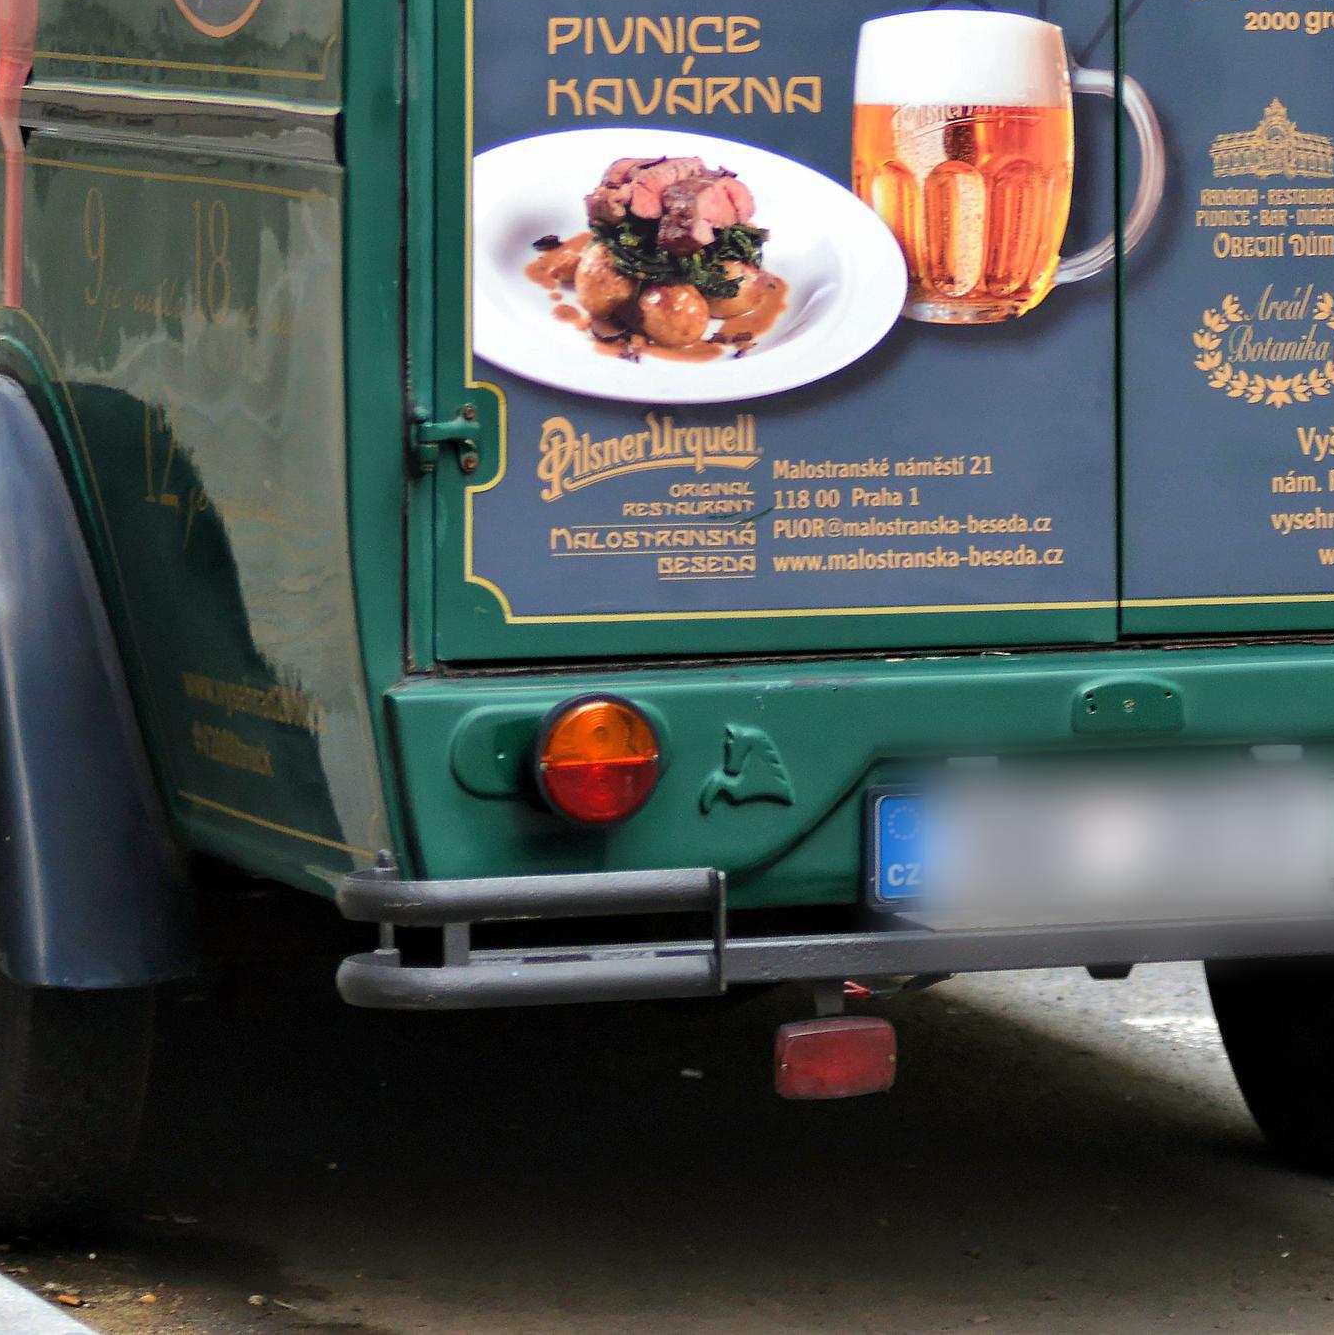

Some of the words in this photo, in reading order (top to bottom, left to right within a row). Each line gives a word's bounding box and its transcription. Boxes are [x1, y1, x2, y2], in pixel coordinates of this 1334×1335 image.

[1244, 11, 1300, 31] 2000
[548, 16, 760, 55] PIVNICE
[548, 56, 822, 116] KAVÁRNA
[1245, 282, 1315, 322] Areál
[1228, 322, 1331, 364] Botanika
[537, 414, 651, 504] Pilsner
[645, 411, 759, 474] Urquell
[773, 459, 889, 479] Malostranské
[895, 457, 964, 476] náměstí
[971, 457, 991, 474] 21
[670, 482, 754, 498] ORIGINAL
[1272, 472, 1321, 493] nám.
[623, 500, 754, 516] RESTAURANT
[775, 490, 810, 509] 118
[815, 490, 841, 507] 00
[852, 487, 903, 506] Praha
[911, 488, 918, 506] 1
[550, 522, 759, 549] MALOSTRANSKÁ
[774, 515, 1051, 538] PUOR@malostranska-beseda.cz
[658, 556, 757, 574] BESEDA
[773, 544, 1063, 571] www.malostranska-beseda.cz
[888, 863, 923, 887] CZ
